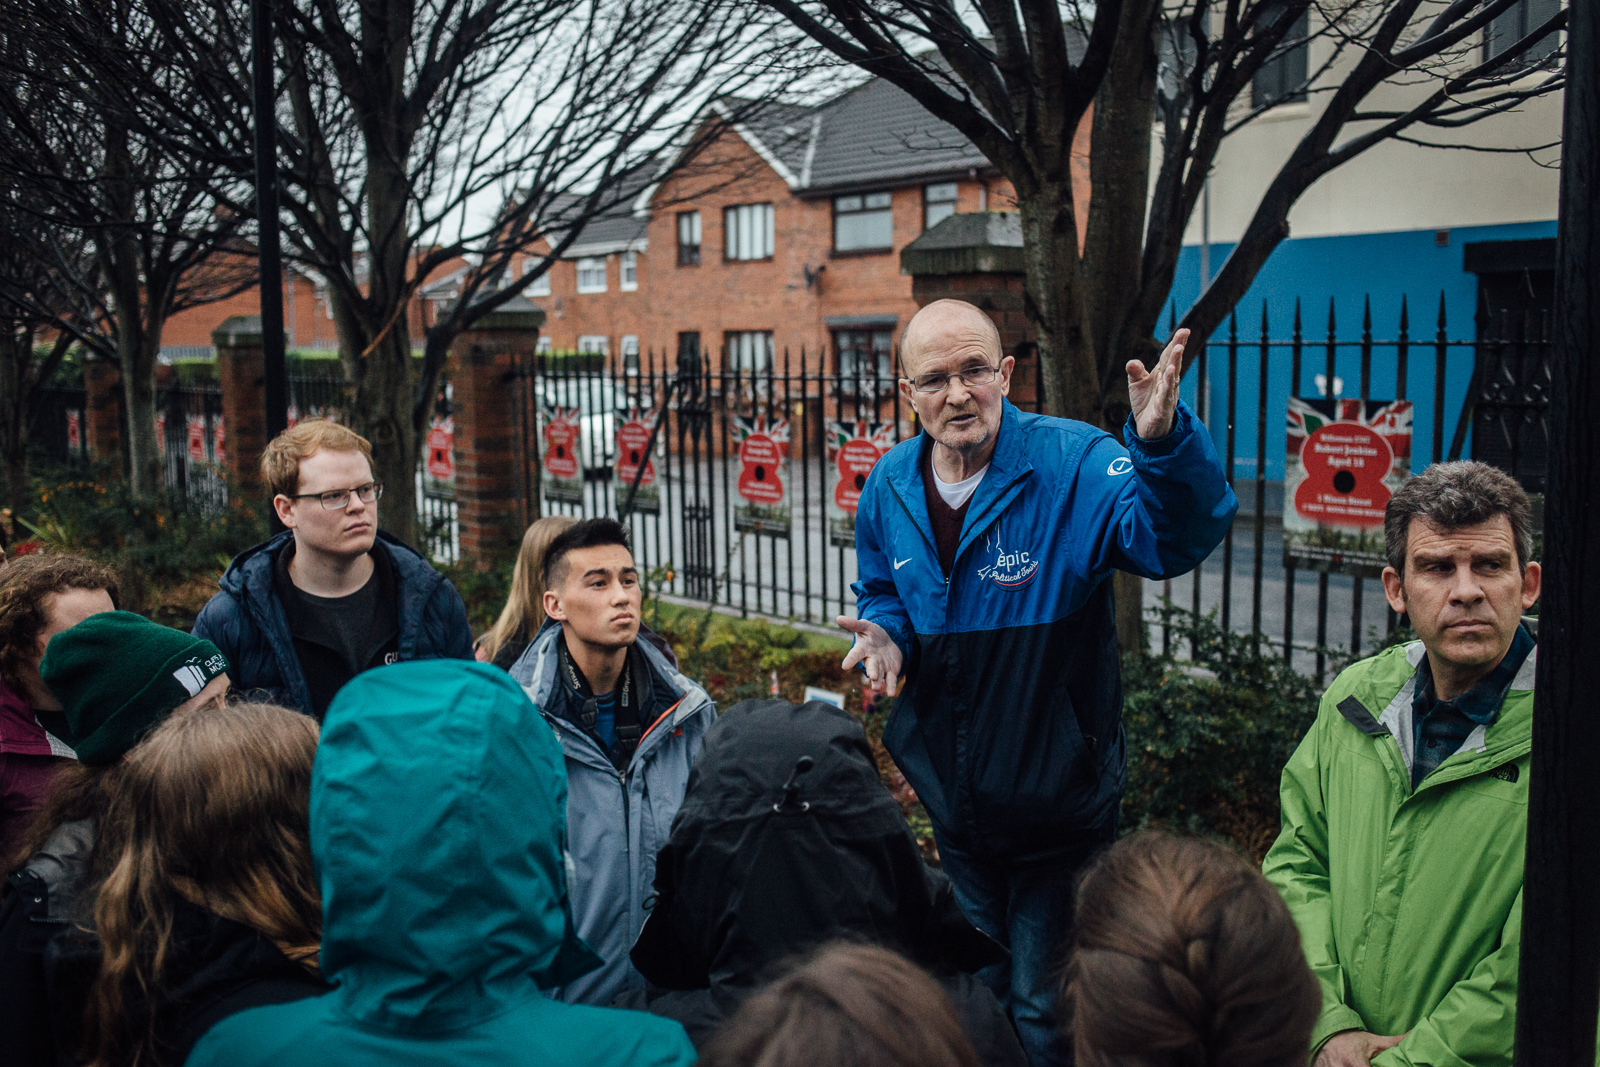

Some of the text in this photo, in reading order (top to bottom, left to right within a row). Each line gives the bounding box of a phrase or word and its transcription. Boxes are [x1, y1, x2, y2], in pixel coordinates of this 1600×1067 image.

[1314, 443, 1378, 456] Robert Jenkins
[1327, 455, 1351, 468] Aged
[1348, 495, 1372, 506] Street
[997, 550, 1030, 573] epic
[989, 560, 1039, 582] Political Tours
